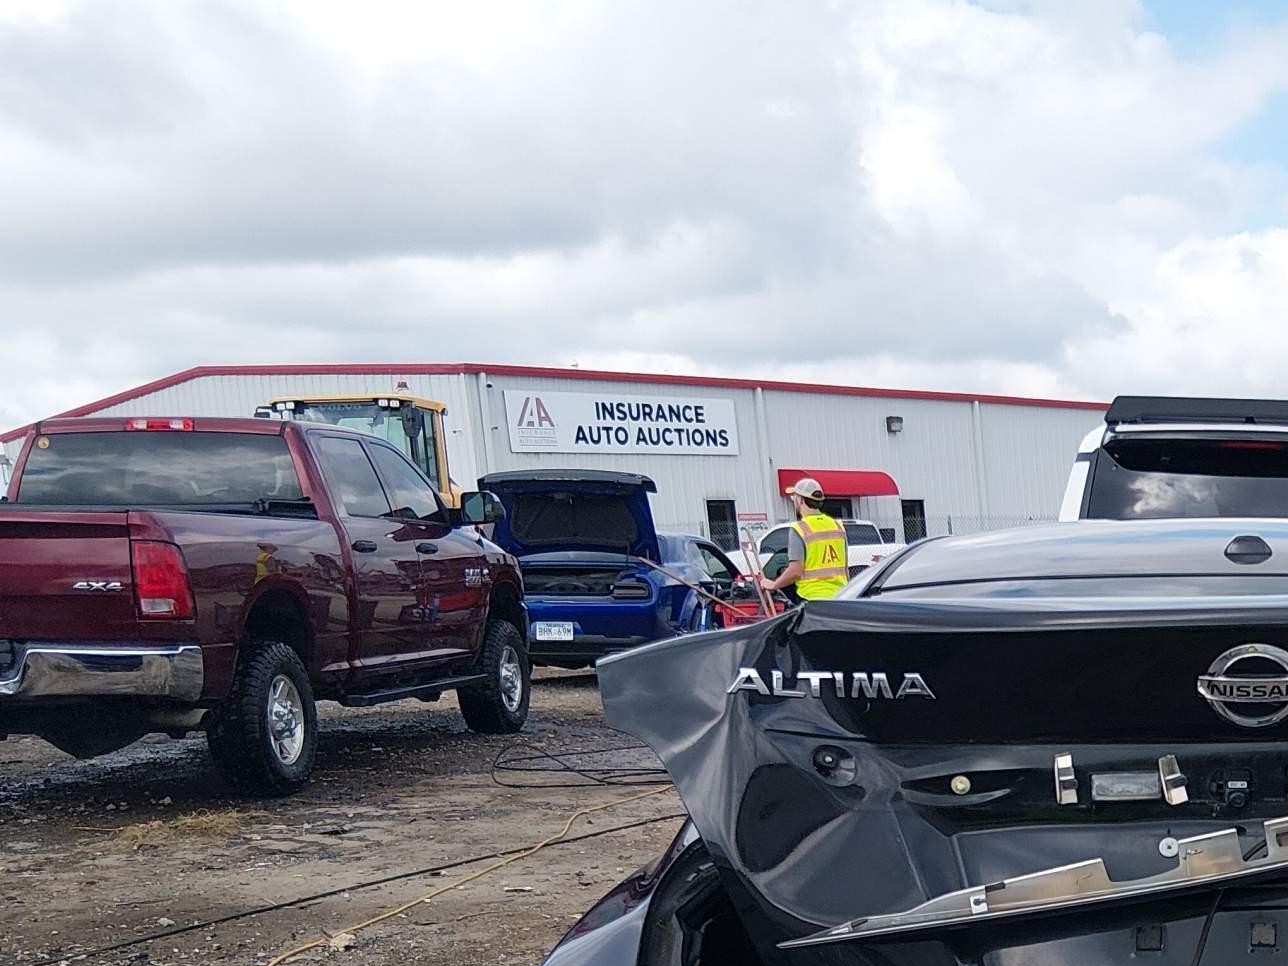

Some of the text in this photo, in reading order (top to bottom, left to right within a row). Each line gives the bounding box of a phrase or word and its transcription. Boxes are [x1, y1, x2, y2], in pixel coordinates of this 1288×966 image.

[595, 402, 706, 424] INSURANCE
[574, 425, 730, 447] AUTO AUCTIONS
[727, 667, 936, 700] ALTIMA
